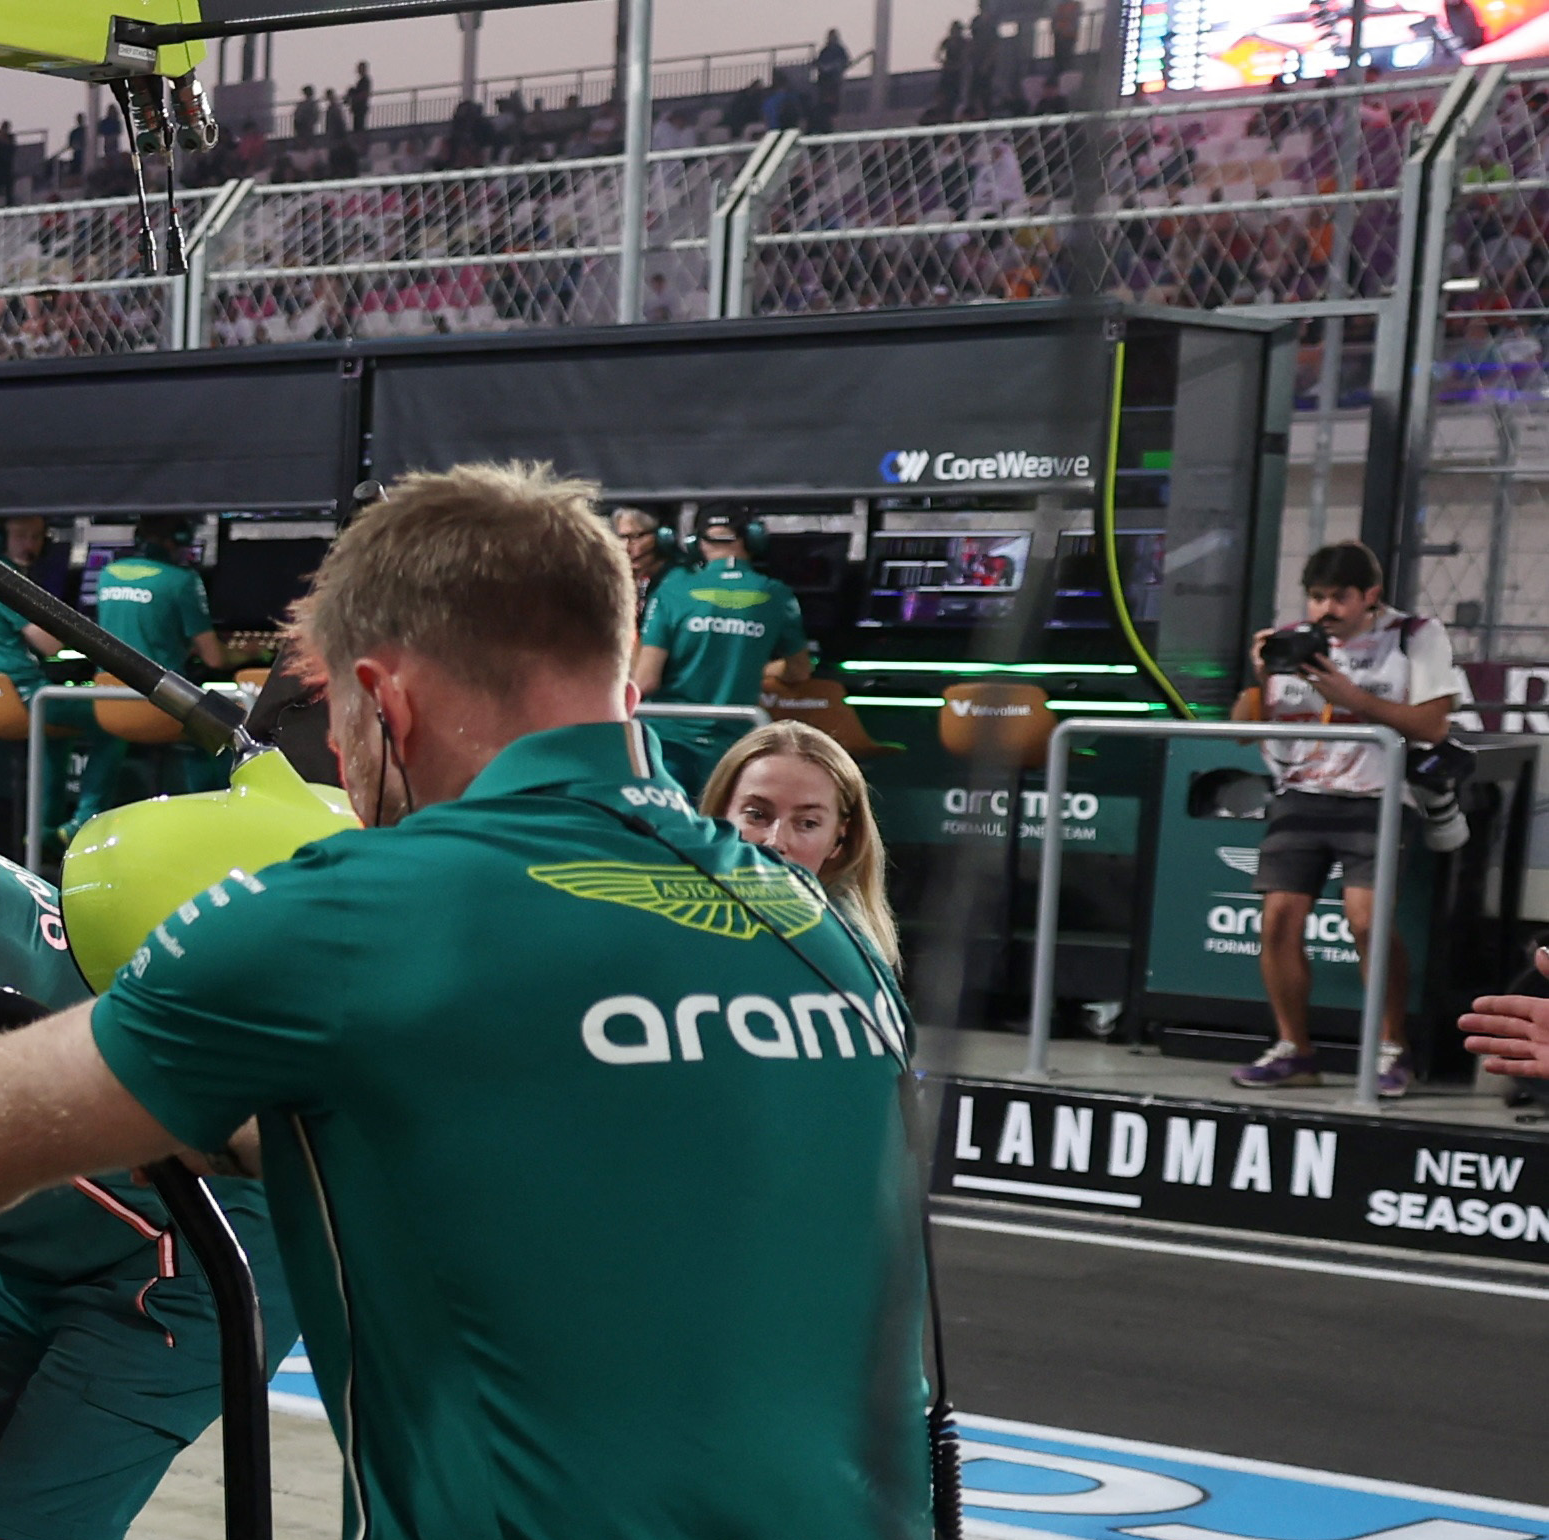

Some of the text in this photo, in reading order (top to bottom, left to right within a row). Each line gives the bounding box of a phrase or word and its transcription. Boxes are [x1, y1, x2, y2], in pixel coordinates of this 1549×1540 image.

[932, 449, 1091, 483] CoreWeave
[686, 615, 767, 639] aramco
[942, 820, 1007, 838] FORMUL
[1204, 936, 1263, 958] FORMU
[955, 1095, 1340, 1200] LANDMAN
[1414, 1148, 1526, 1193] NEW
